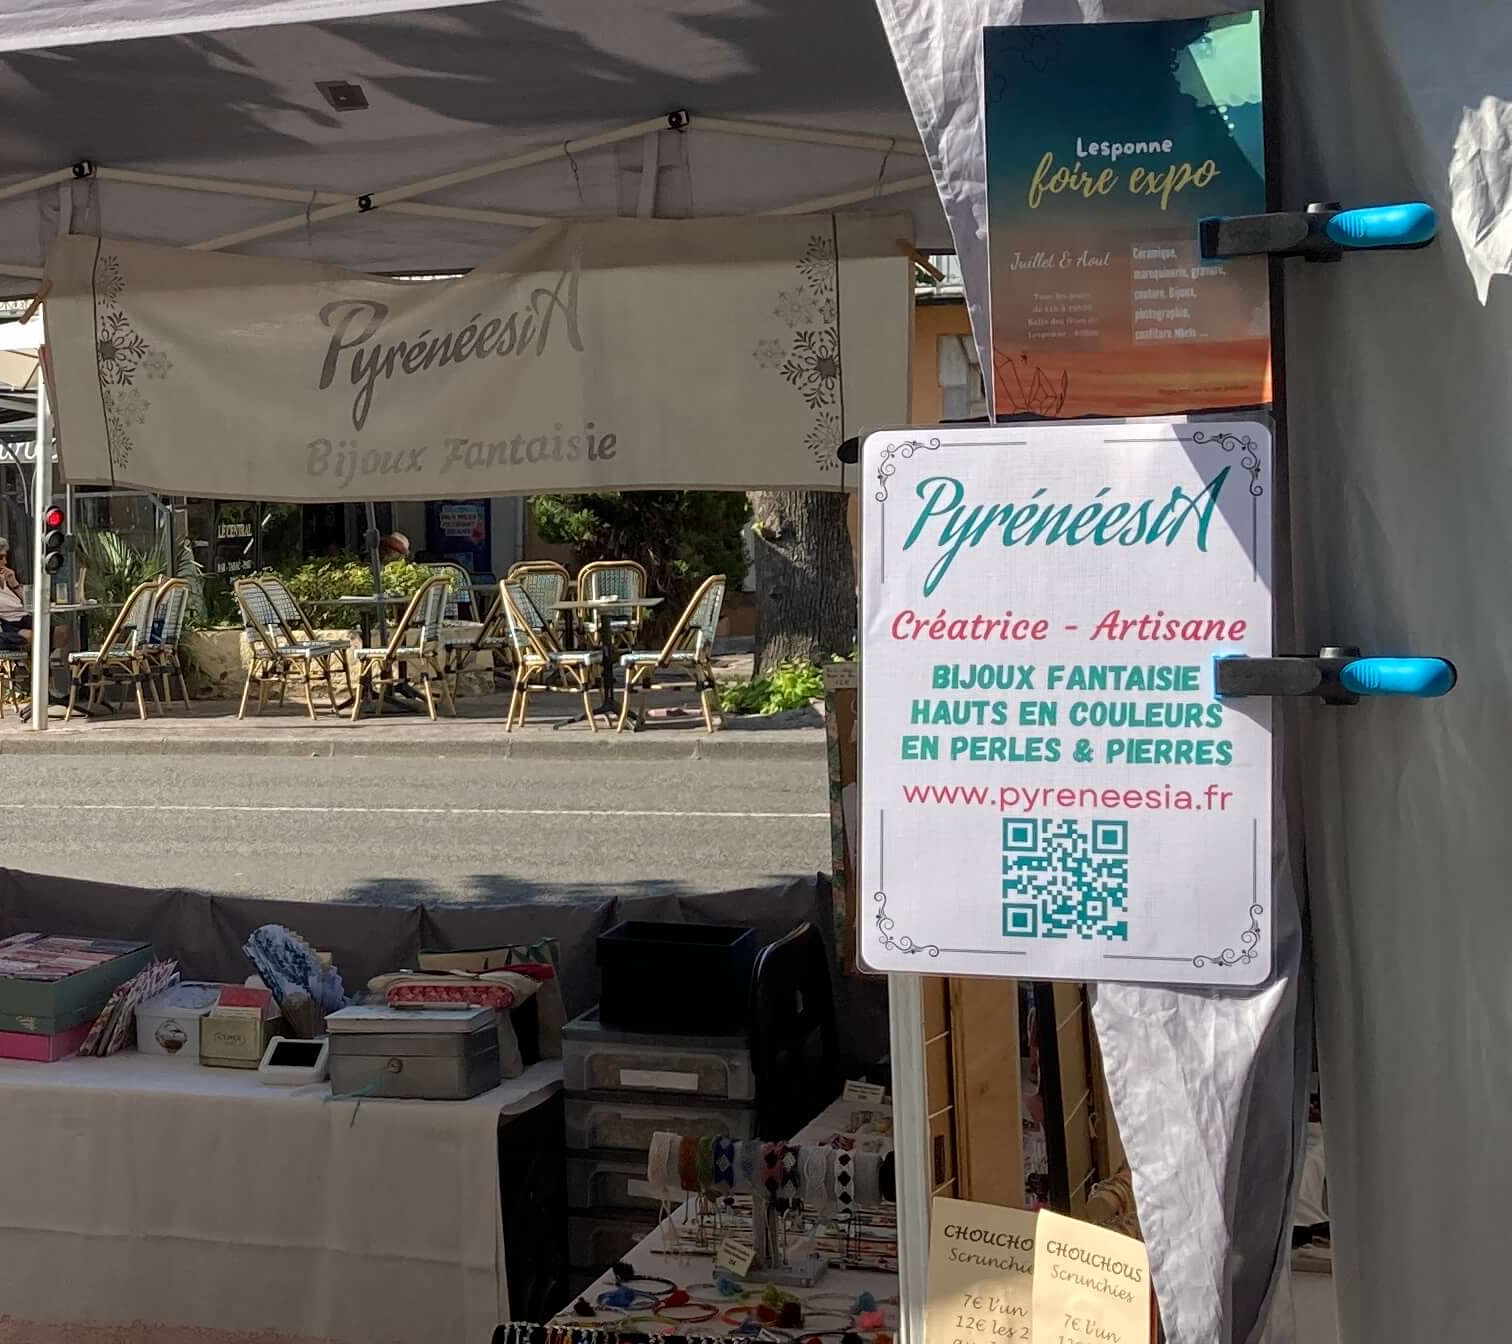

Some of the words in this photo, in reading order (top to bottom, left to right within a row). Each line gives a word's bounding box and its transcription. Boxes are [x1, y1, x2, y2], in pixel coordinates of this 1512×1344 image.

[1076, 137, 1173, 161] Lesponne
[1028, 152, 1119, 208] foire
[1129, 159, 1220, 210] expo
[1010, 251, 1055, 270] Juillet
[1058, 250, 1074, 269] &
[305, 436, 428, 489] Bijoux
[440, 420, 617, 475] Fantaisie
[891, 608, 1049, 642] Créatrice
[1090, 609, 1248, 642] Artisane
[932, 664, 1034, 691] BIJOUX
[1047, 665, 1201, 692] FANTAISIE
[910, 700, 1008, 727] HAUTS
[1019, 701, 1058, 727] EN
[1069, 701, 1224, 729] COULEURS
[901, 736, 940, 762] EN
[951, 737, 1061, 763] PERLES
[1074, 739, 1095, 763] &
[1106, 738, 1234, 766] PIERRES
[902, 782, 1234, 813] www.pyreneesia.fr
[943, 1224, 1034, 1252] CHOUCHO
[1046, 1240, 1143, 1283] CHOUCHOUS
[1050, 1264, 1136, 1304] Scrunchies
[963, 1293, 983, 1310] 7€
[988, 1296, 1029, 1318] l'un
[955, 1315, 987, 1332] 12€
[992, 1320, 1019, 1339] les
[1020, 1326, 1030, 1340] 2
[1063, 1313, 1081, 1331] 7€
[1085, 1319, 1121, 1344] l'un
